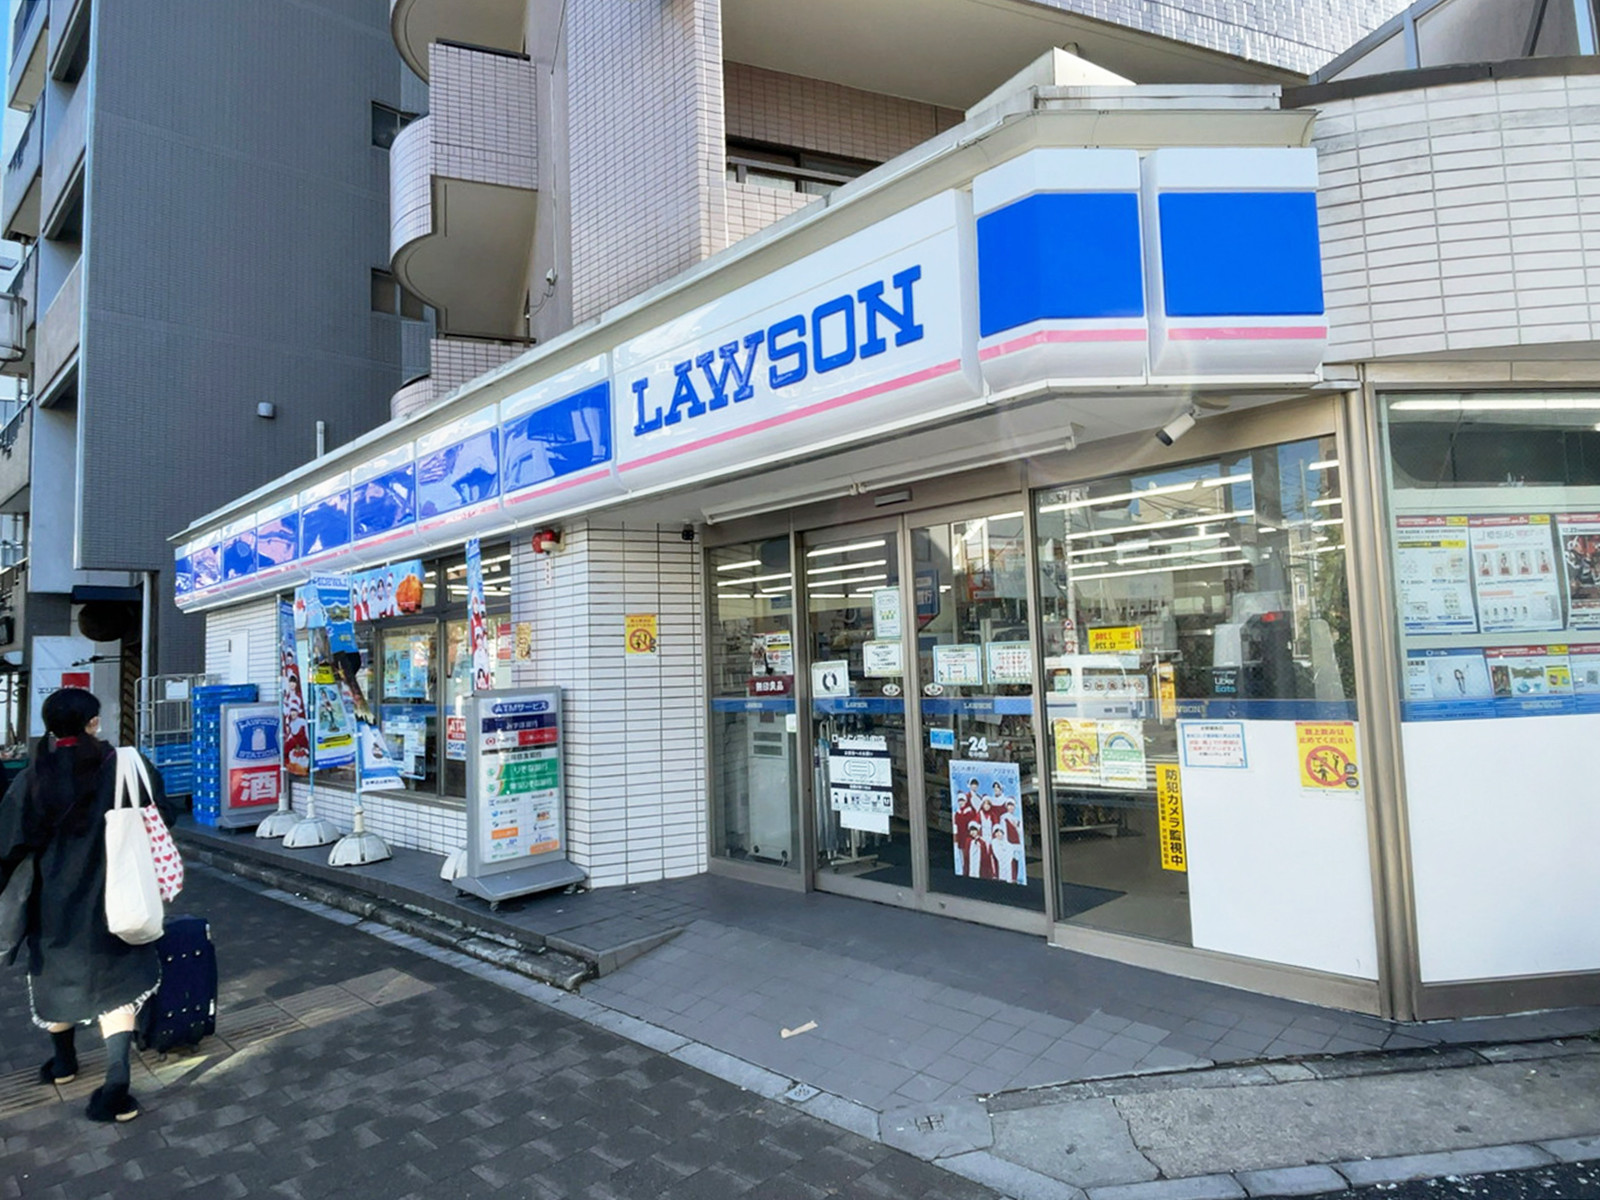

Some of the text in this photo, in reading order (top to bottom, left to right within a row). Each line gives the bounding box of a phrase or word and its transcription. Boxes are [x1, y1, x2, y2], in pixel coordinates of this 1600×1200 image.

[632, 264, 923, 436] LAWSON
[755, 680, 785, 692] 無印良品
[1214, 677, 1235, 685] Uber
[1215, 685, 1236, 693] Eats
[494, 701, 548, 713] ATMサービス
[968, 736, 988, 752] 24
[240, 770, 278, 801] 酒
[1165, 769, 1183, 866] 防犯カメラ監視中
